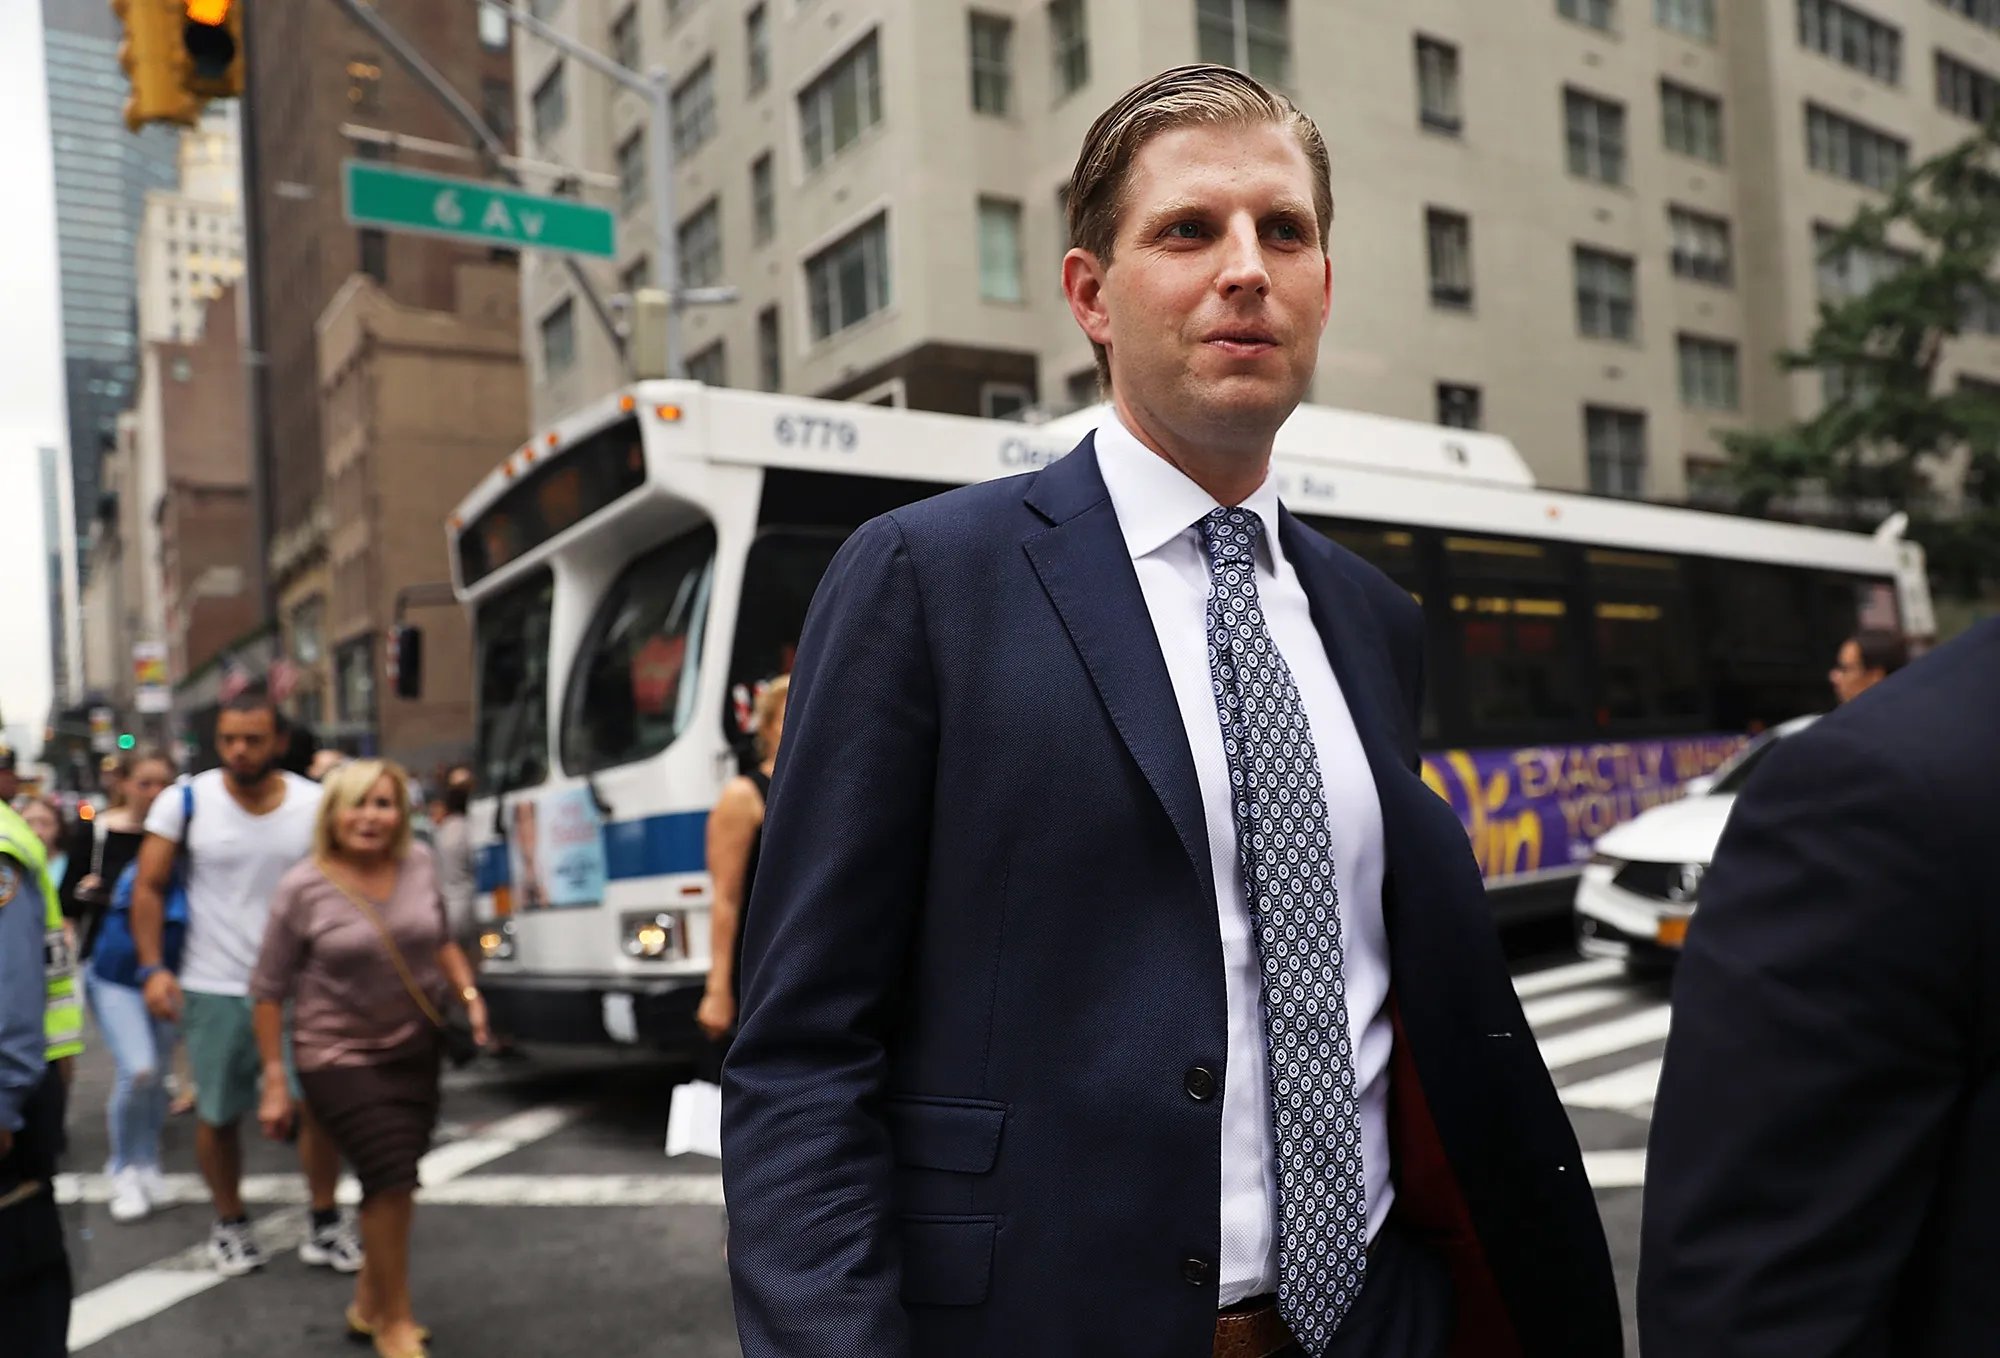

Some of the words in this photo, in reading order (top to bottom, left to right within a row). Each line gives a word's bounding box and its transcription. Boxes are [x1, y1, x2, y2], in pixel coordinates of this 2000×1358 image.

[432, 188, 465, 227] 6
[480, 199, 547, 238] Av
[773, 412, 860, 453] 6779
[1513, 741, 1664, 798] EXACTLY
